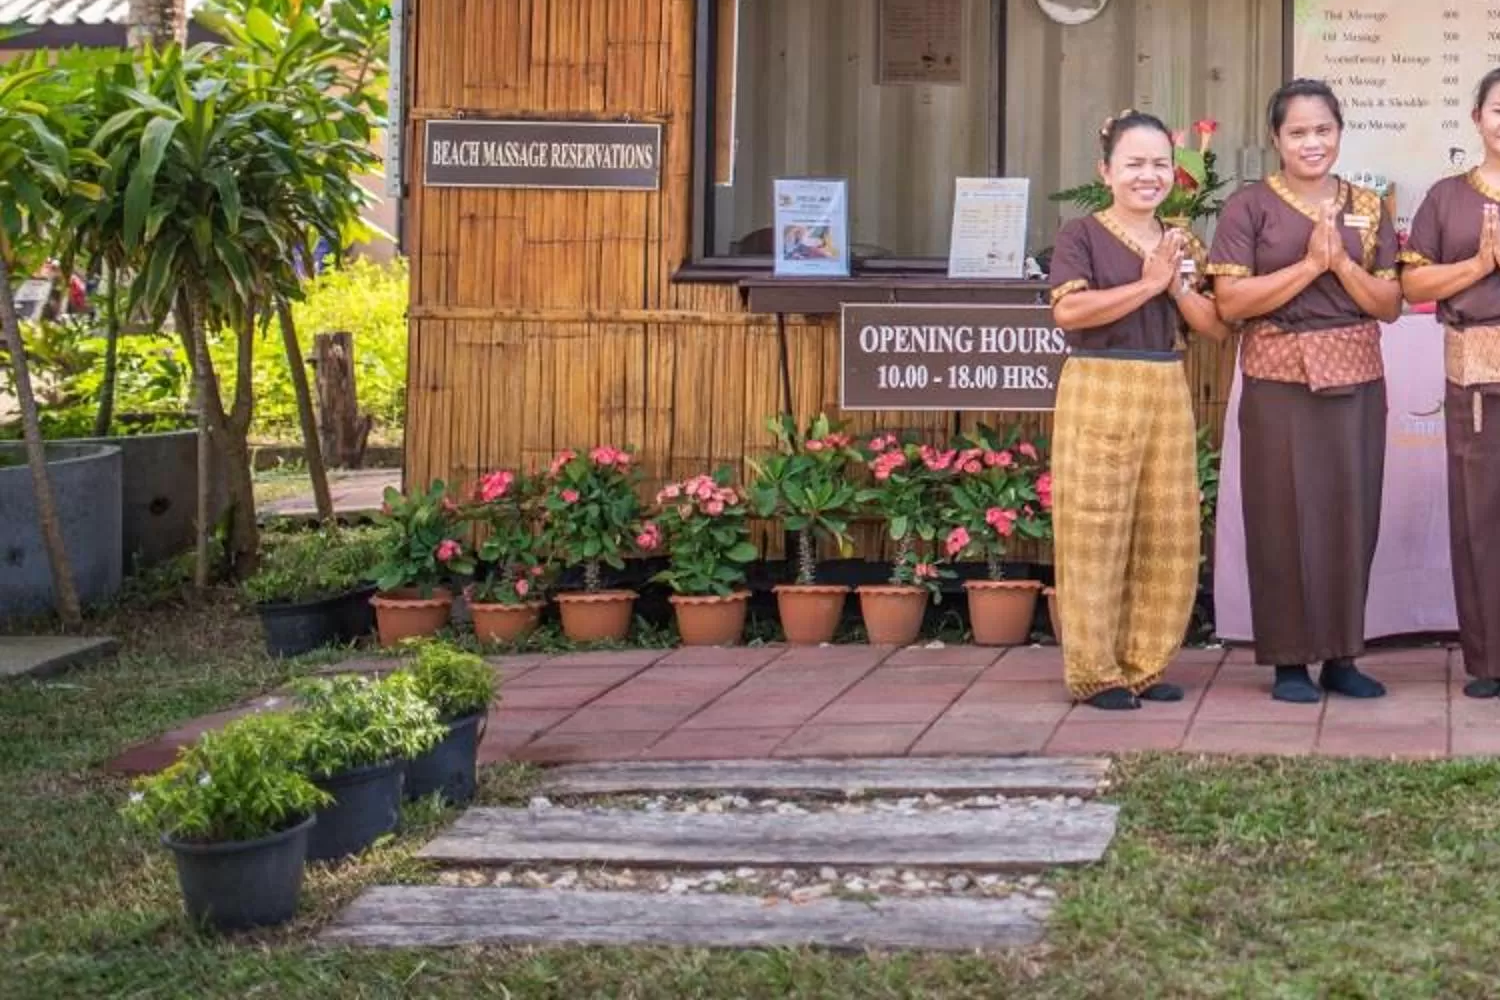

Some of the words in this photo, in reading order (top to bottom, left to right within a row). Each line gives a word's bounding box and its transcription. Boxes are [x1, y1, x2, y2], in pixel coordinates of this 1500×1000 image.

[1391, 52, 1431, 67] Massage
[431, 140, 480, 166] BEACH
[482, 141, 548, 168] MASSAGE
[551, 142, 653, 169] RESERVATIONS
[859, 325, 975, 353] OPENING
[979, 326, 1073, 354] HOURS.
[877, 364, 929, 389] 10.00
[947, 365, 997, 389] 18.00
[1002, 365, 1054, 390] HRS.
